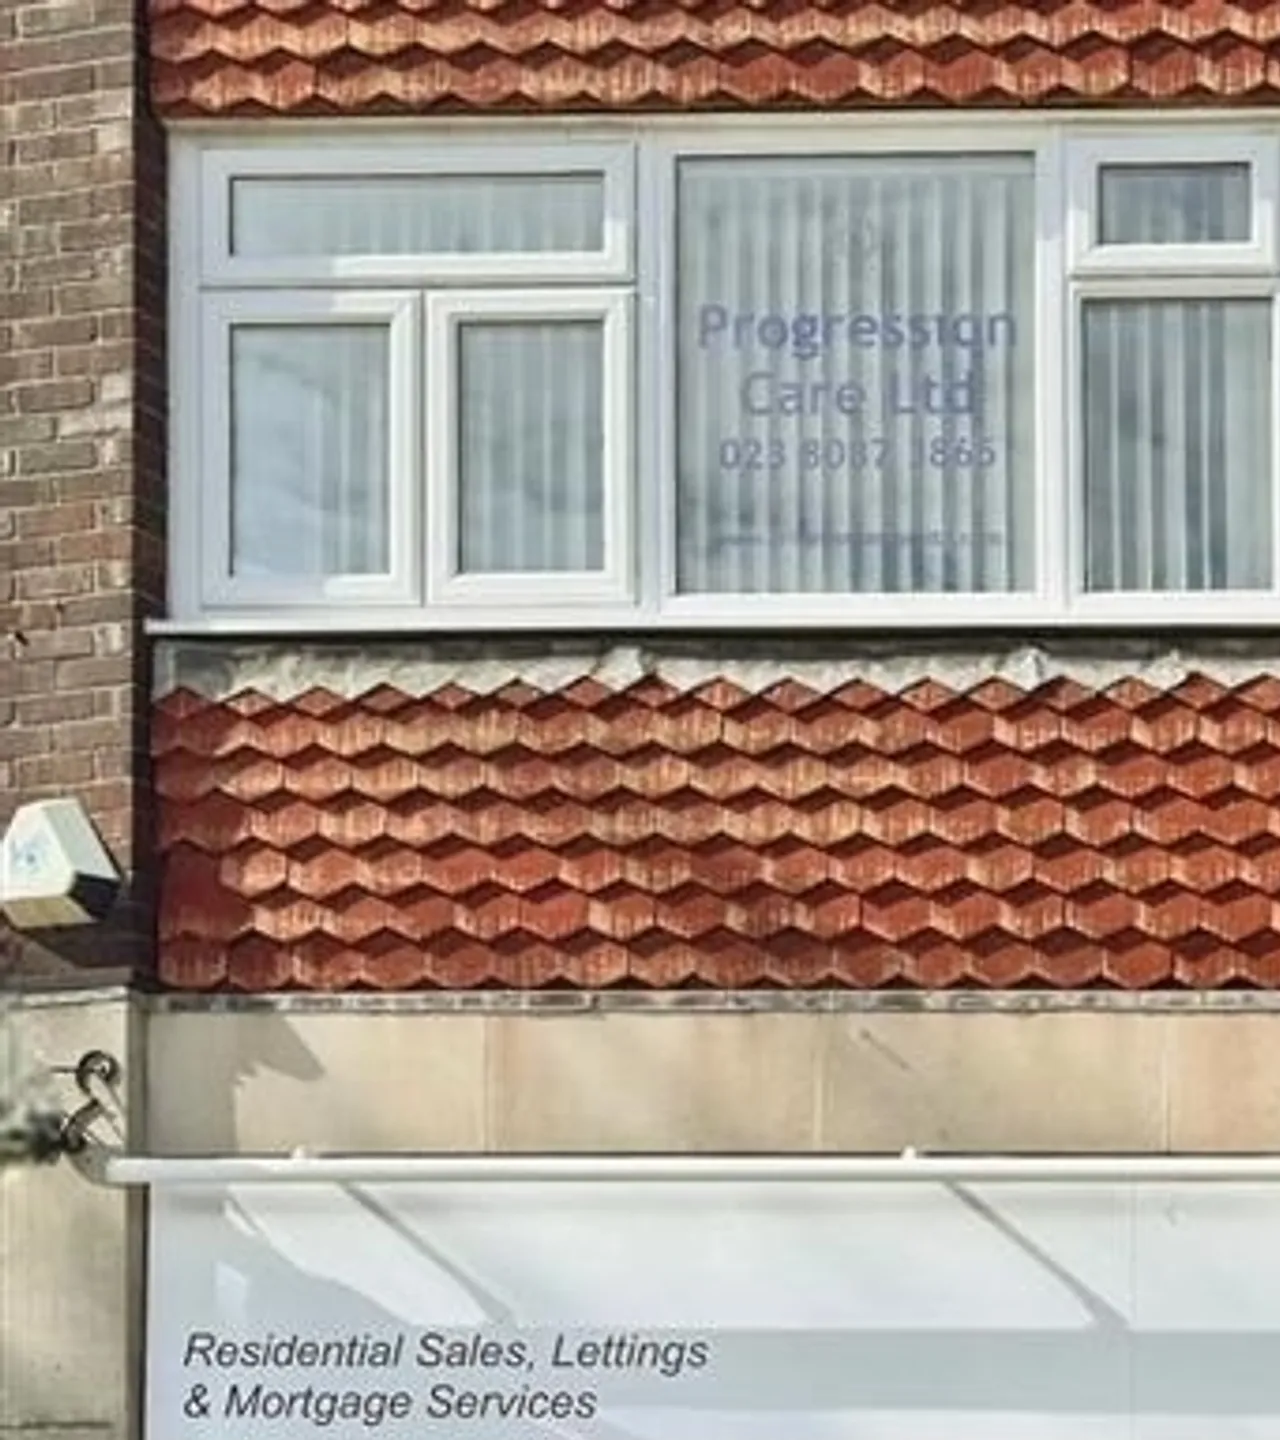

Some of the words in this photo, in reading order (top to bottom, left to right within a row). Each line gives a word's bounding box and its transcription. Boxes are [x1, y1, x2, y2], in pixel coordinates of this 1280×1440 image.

[699, 304, 1017, 360] Progression
[740, 372, 866, 416] Care
[888, 371, 983, 415] Ltd
[719, 438, 786, 471] 023
[183, 1332, 403, 1369] Residential
[415, 1332, 536, 1373] Sales,
[551, 1334, 710, 1378] Lettings
[183, 1383, 210, 1419] &
[224, 1384, 413, 1426] Mortgage
[427, 1384, 596, 1419] Services
